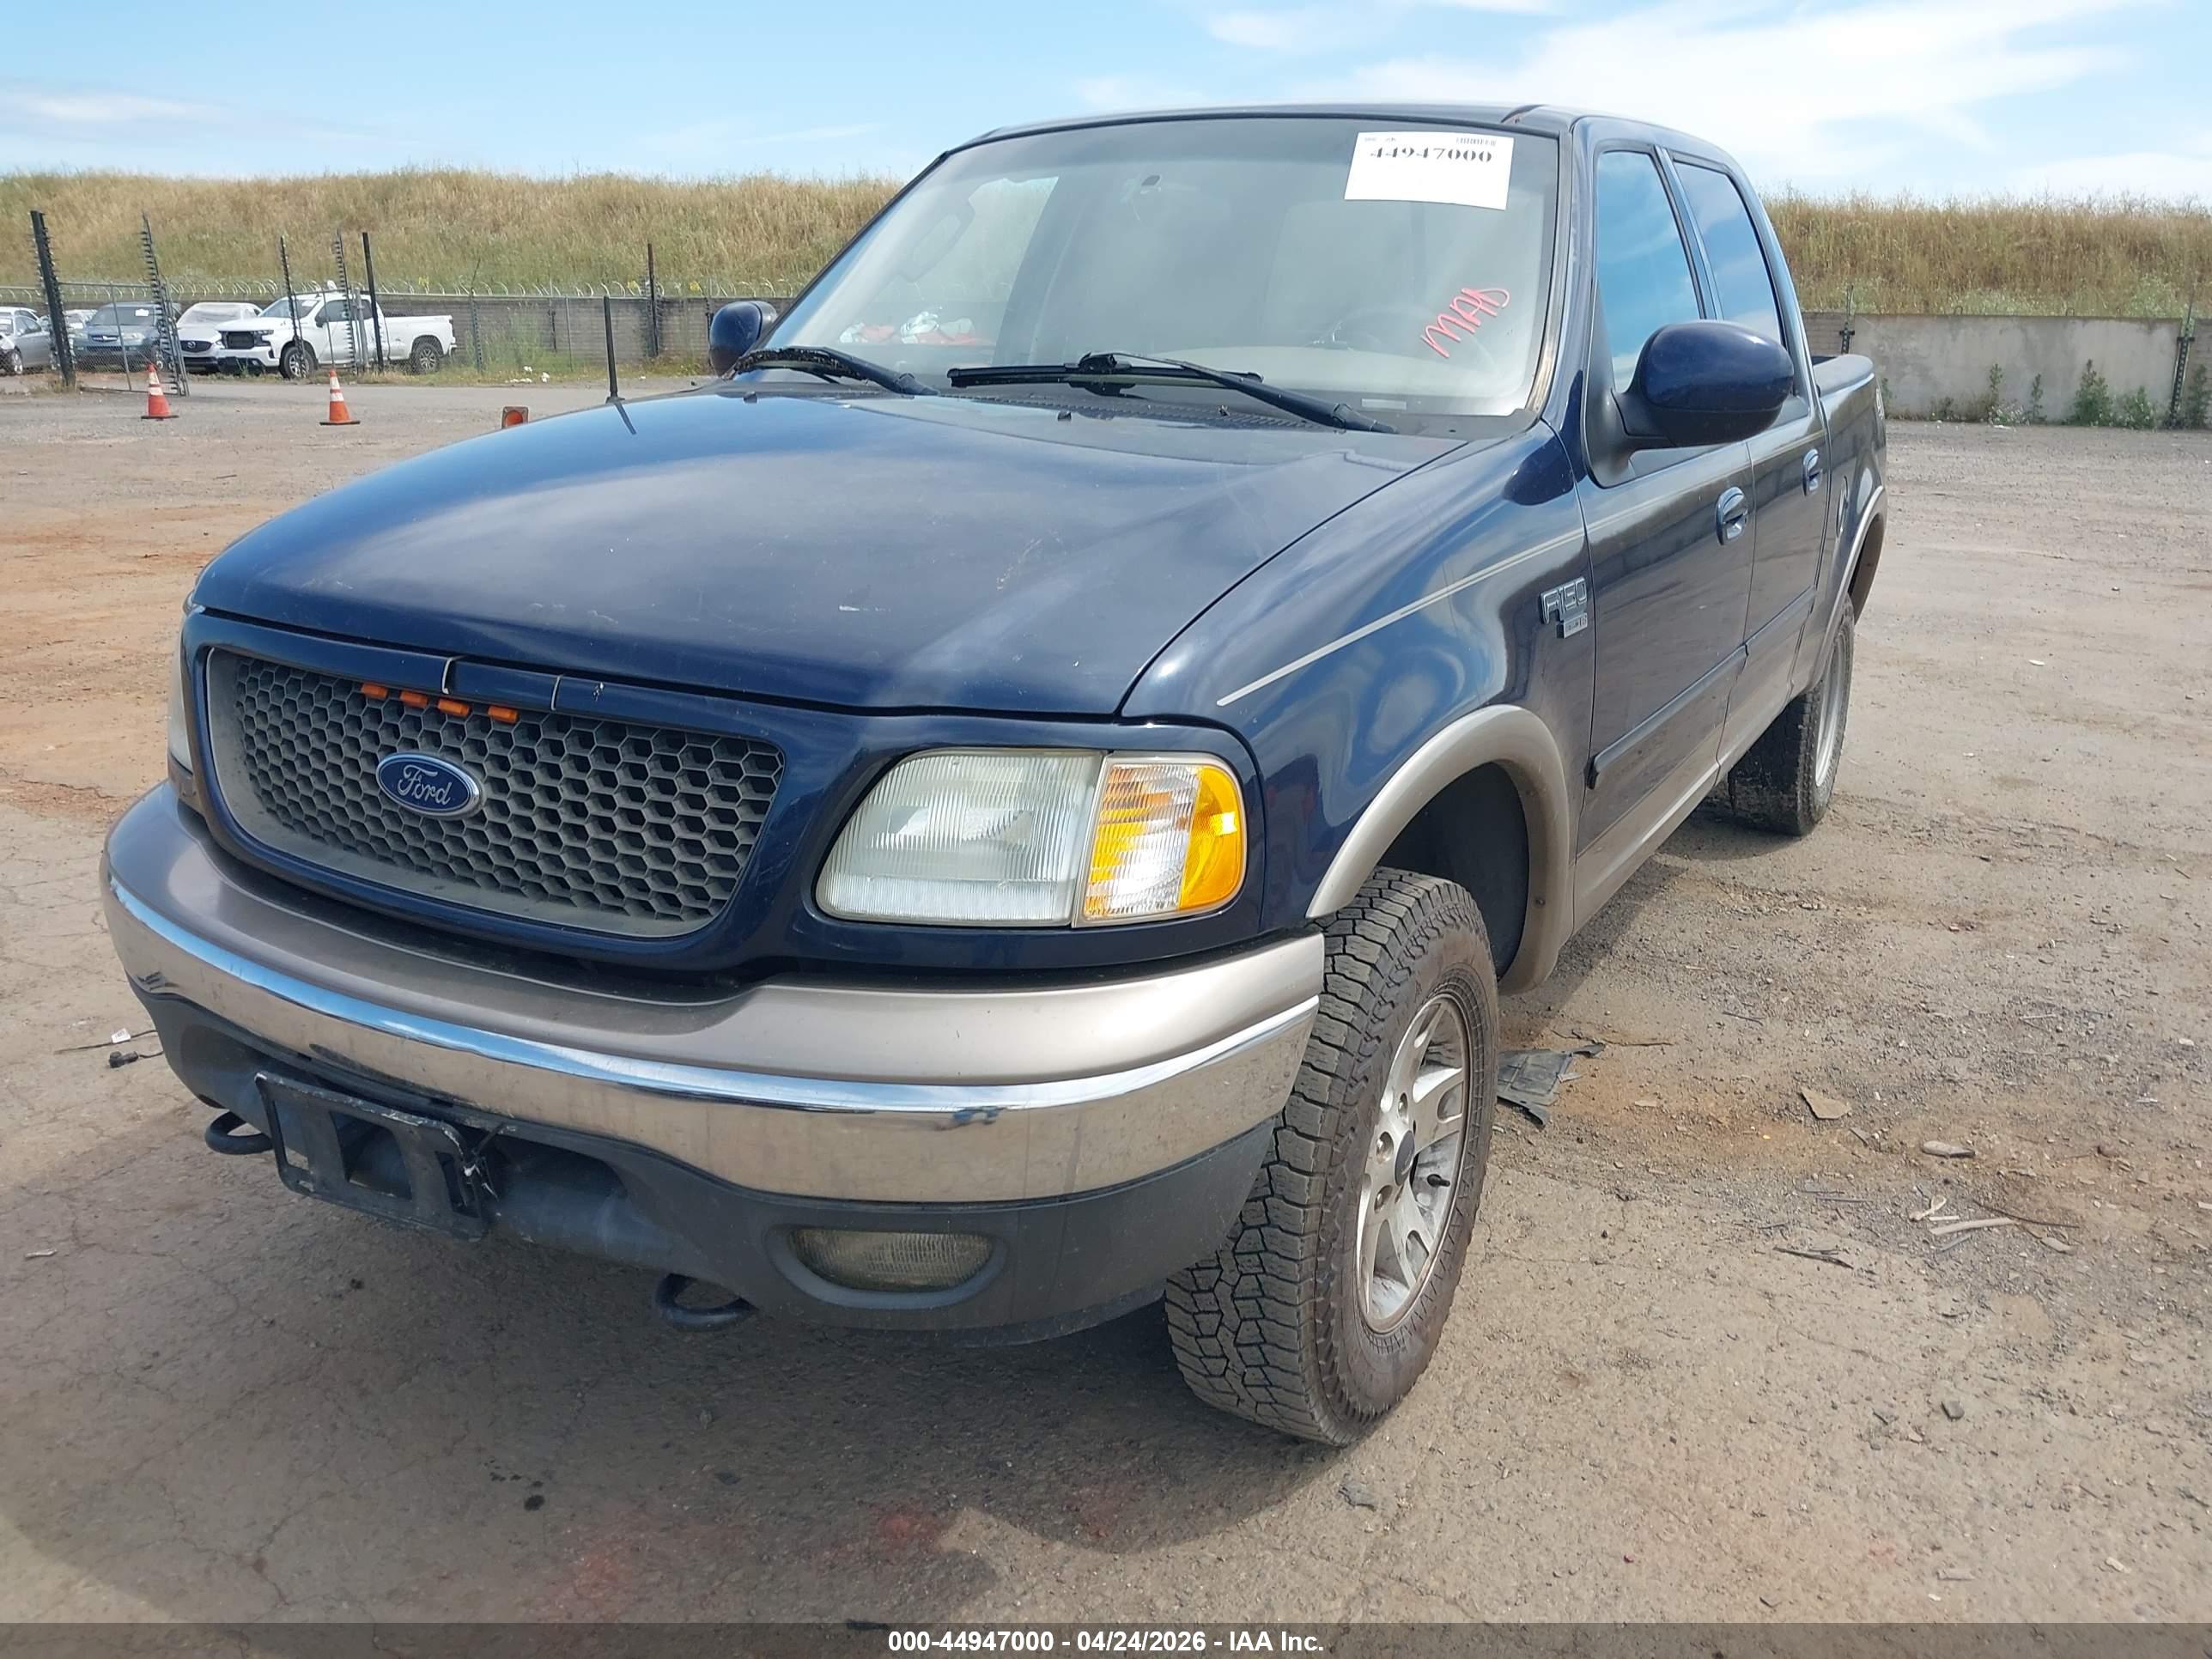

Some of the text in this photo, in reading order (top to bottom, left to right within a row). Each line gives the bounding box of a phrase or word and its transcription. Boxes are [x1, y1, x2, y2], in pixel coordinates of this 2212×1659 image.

[1370, 147, 1492, 162] 44947000
[1419, 287, 1510, 359] MAD
[397, 764, 453, 805] Ford
